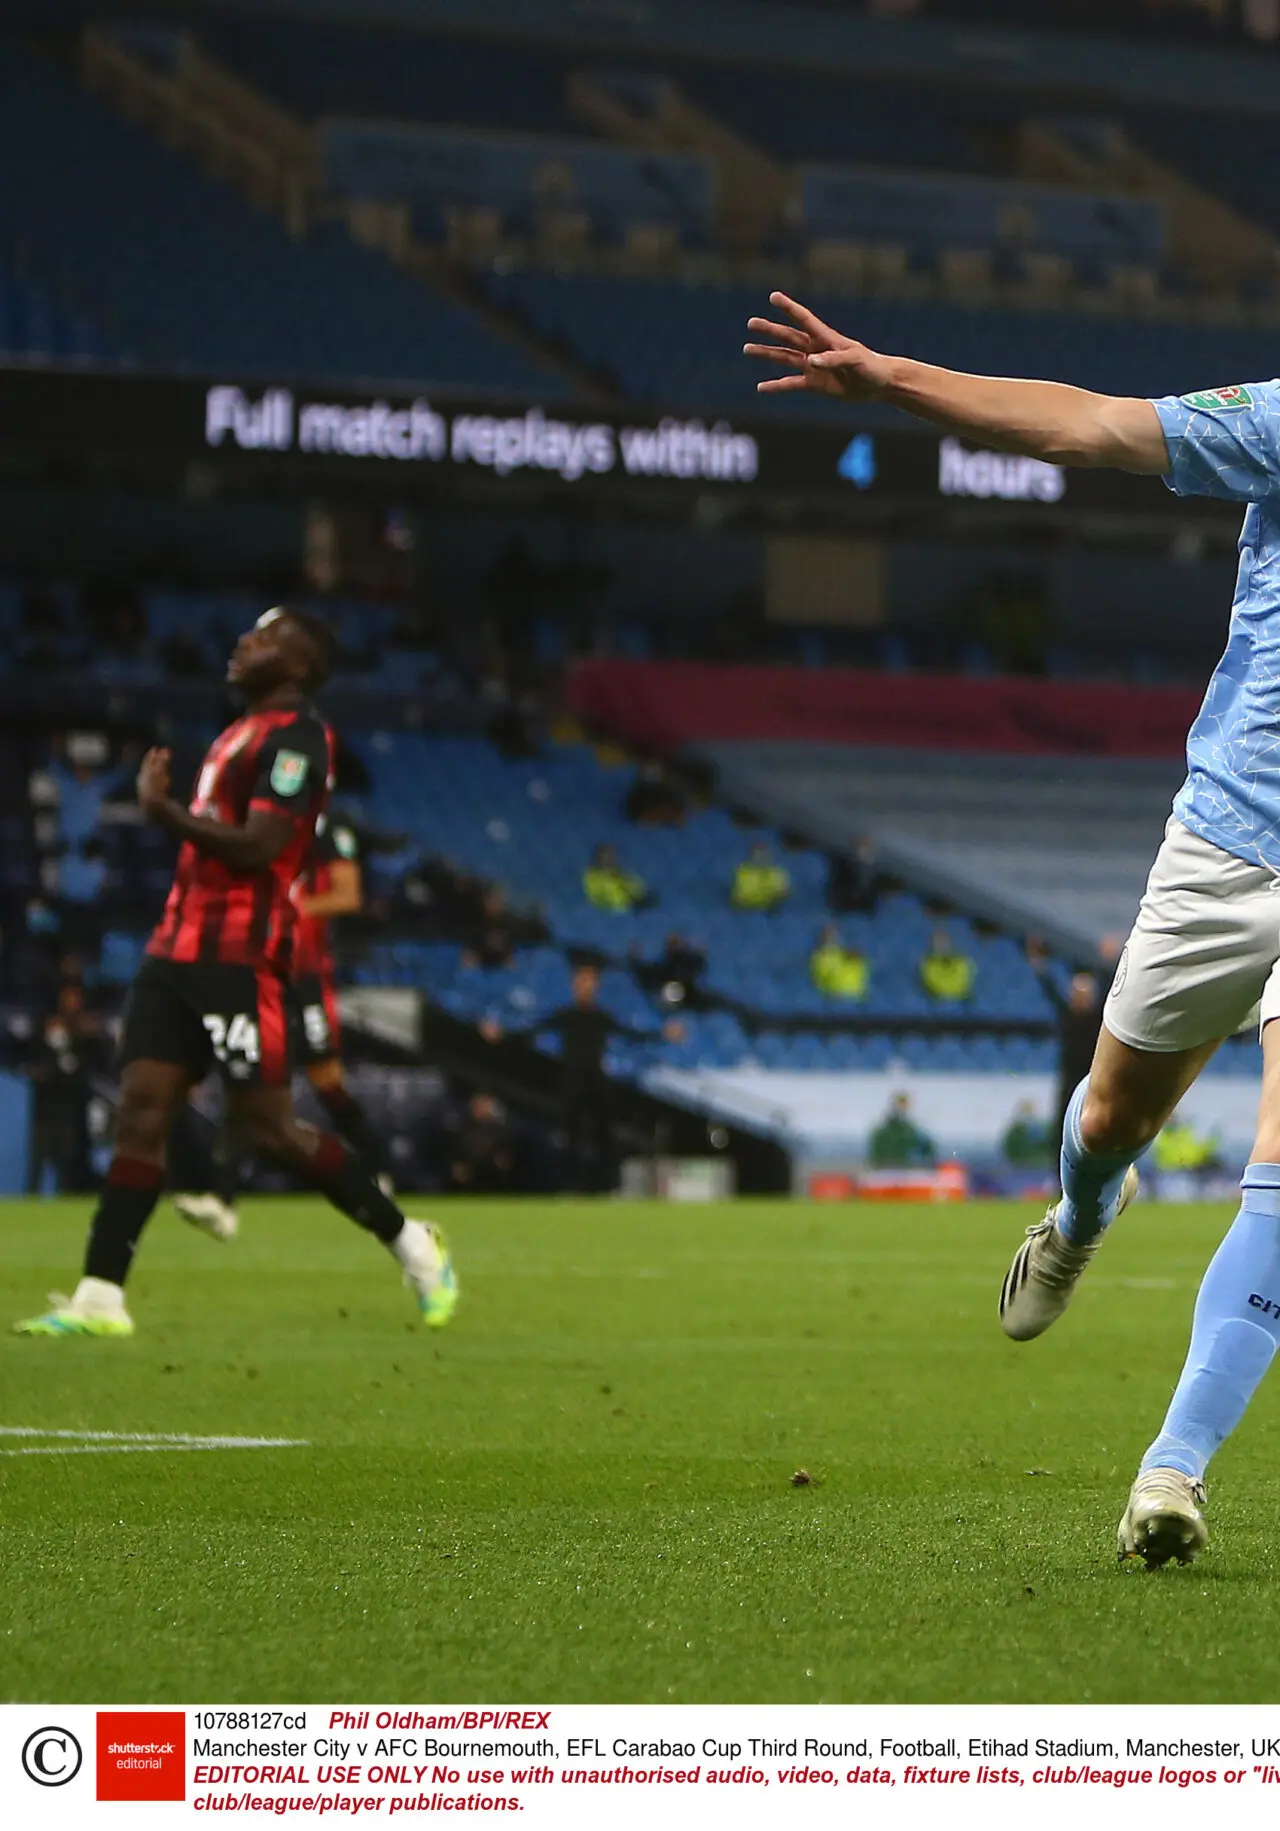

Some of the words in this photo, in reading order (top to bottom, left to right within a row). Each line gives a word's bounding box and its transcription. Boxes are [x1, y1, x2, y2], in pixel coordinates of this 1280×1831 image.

[206, 386, 293, 449] Full
[300, 401, 446, 460] match
[450, 407, 615, 480] replays
[619, 419, 758, 481] within
[838, 434, 876, 488] 4
[939, 437, 1064, 501] hours
